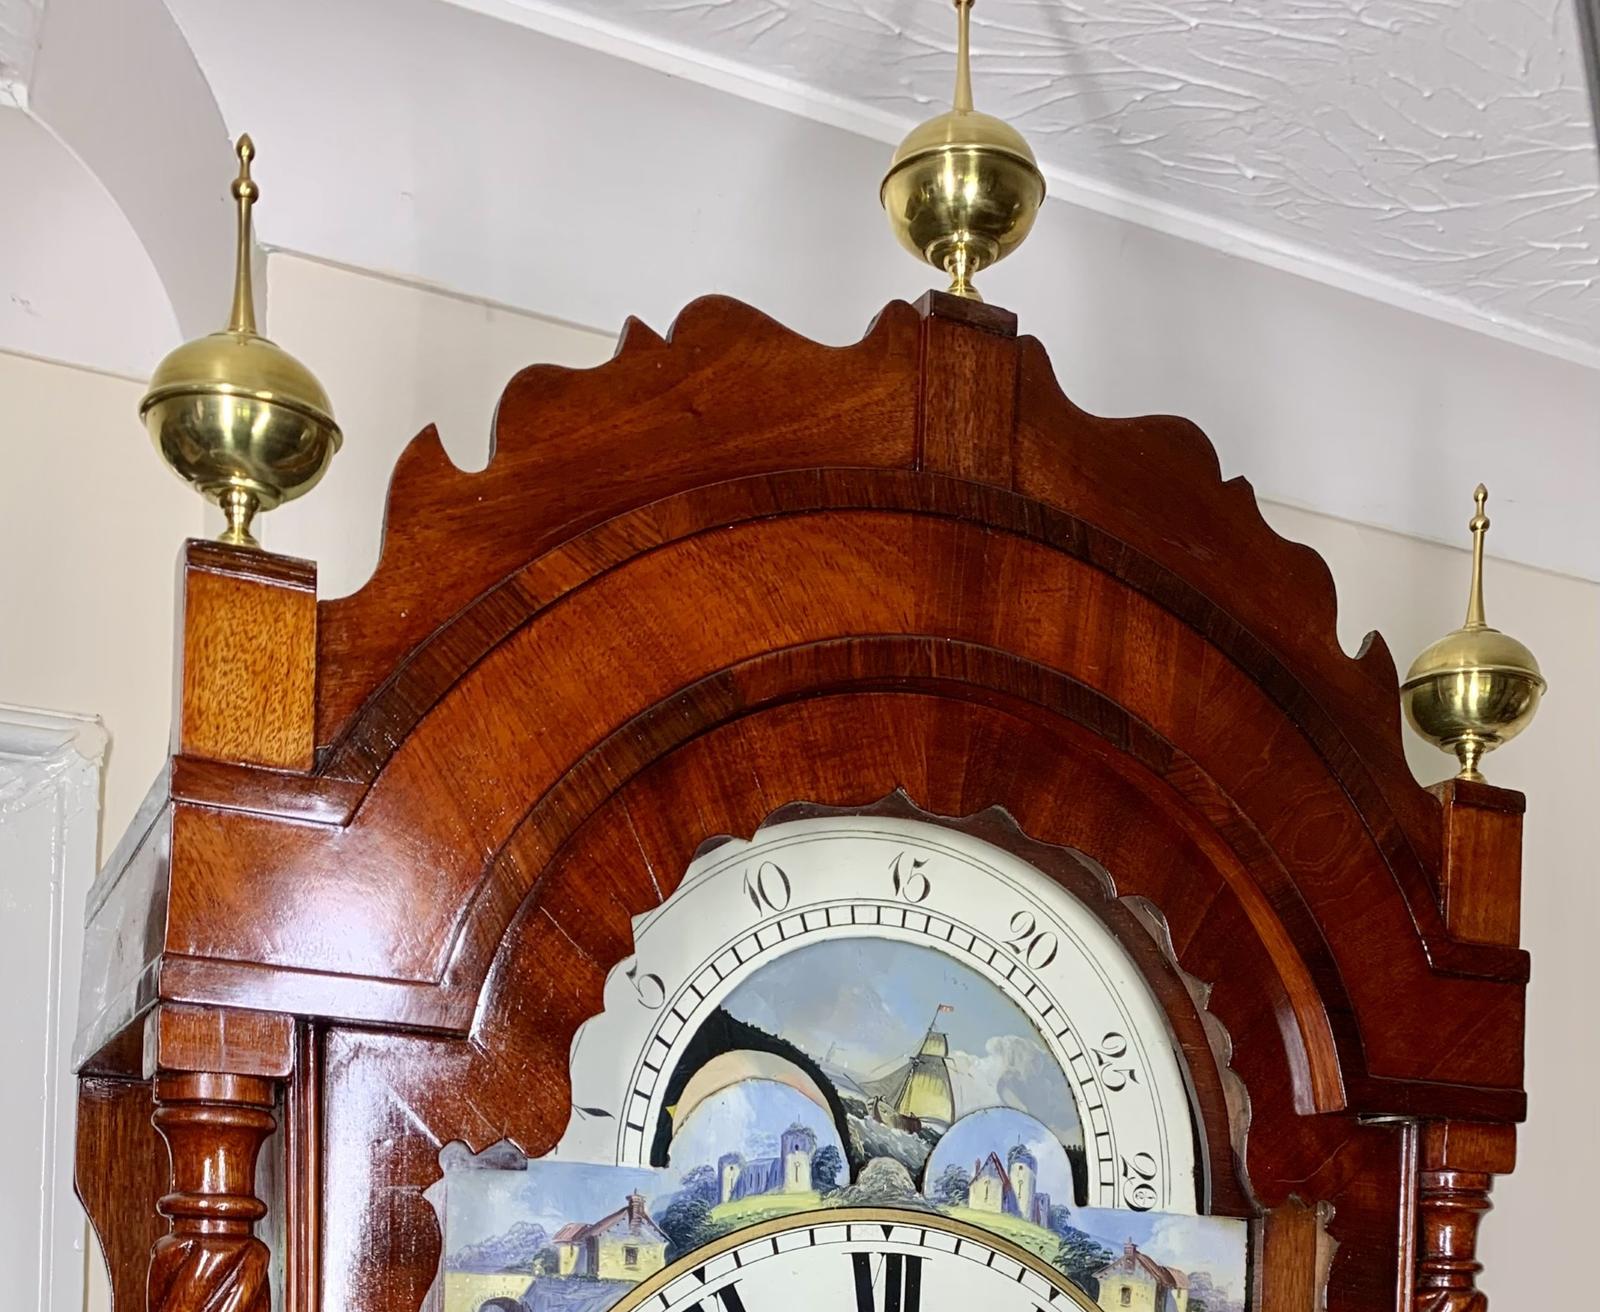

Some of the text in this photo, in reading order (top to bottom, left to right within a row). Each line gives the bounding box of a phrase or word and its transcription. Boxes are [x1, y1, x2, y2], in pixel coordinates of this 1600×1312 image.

[742, 860, 791, 918] 10
[887, 851, 930, 904] 15
[1004, 910, 1058, 971] 20
[625, 958, 665, 1009] 5
[1091, 1031, 1138, 1092] 25
